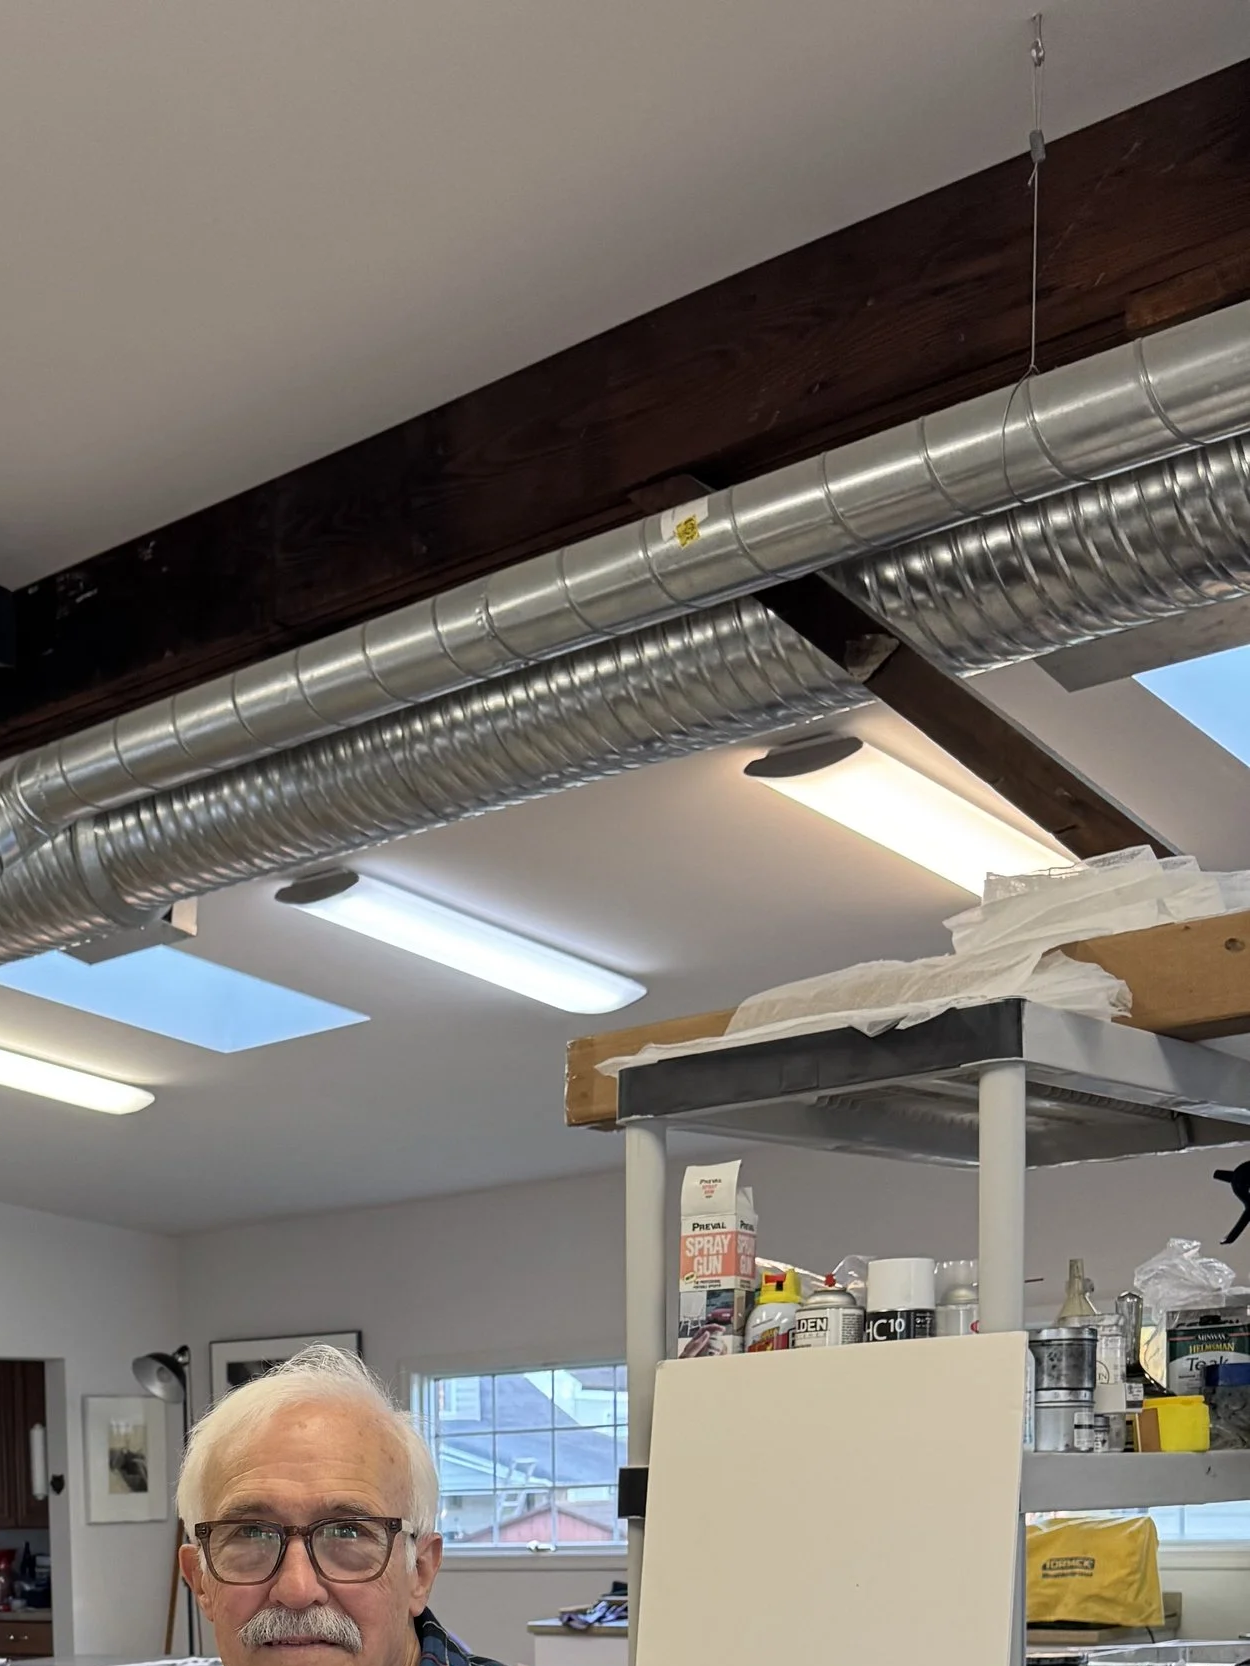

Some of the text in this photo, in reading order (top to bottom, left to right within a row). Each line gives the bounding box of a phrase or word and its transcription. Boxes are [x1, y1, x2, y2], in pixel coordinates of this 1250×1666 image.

[692, 1222, 727, 1231] PREVAL
[685, 1234, 731, 1258] SPRAY
[693, 1255, 723, 1276] GUN
[1189, 1342, 1236, 1354] HELMSMAN
